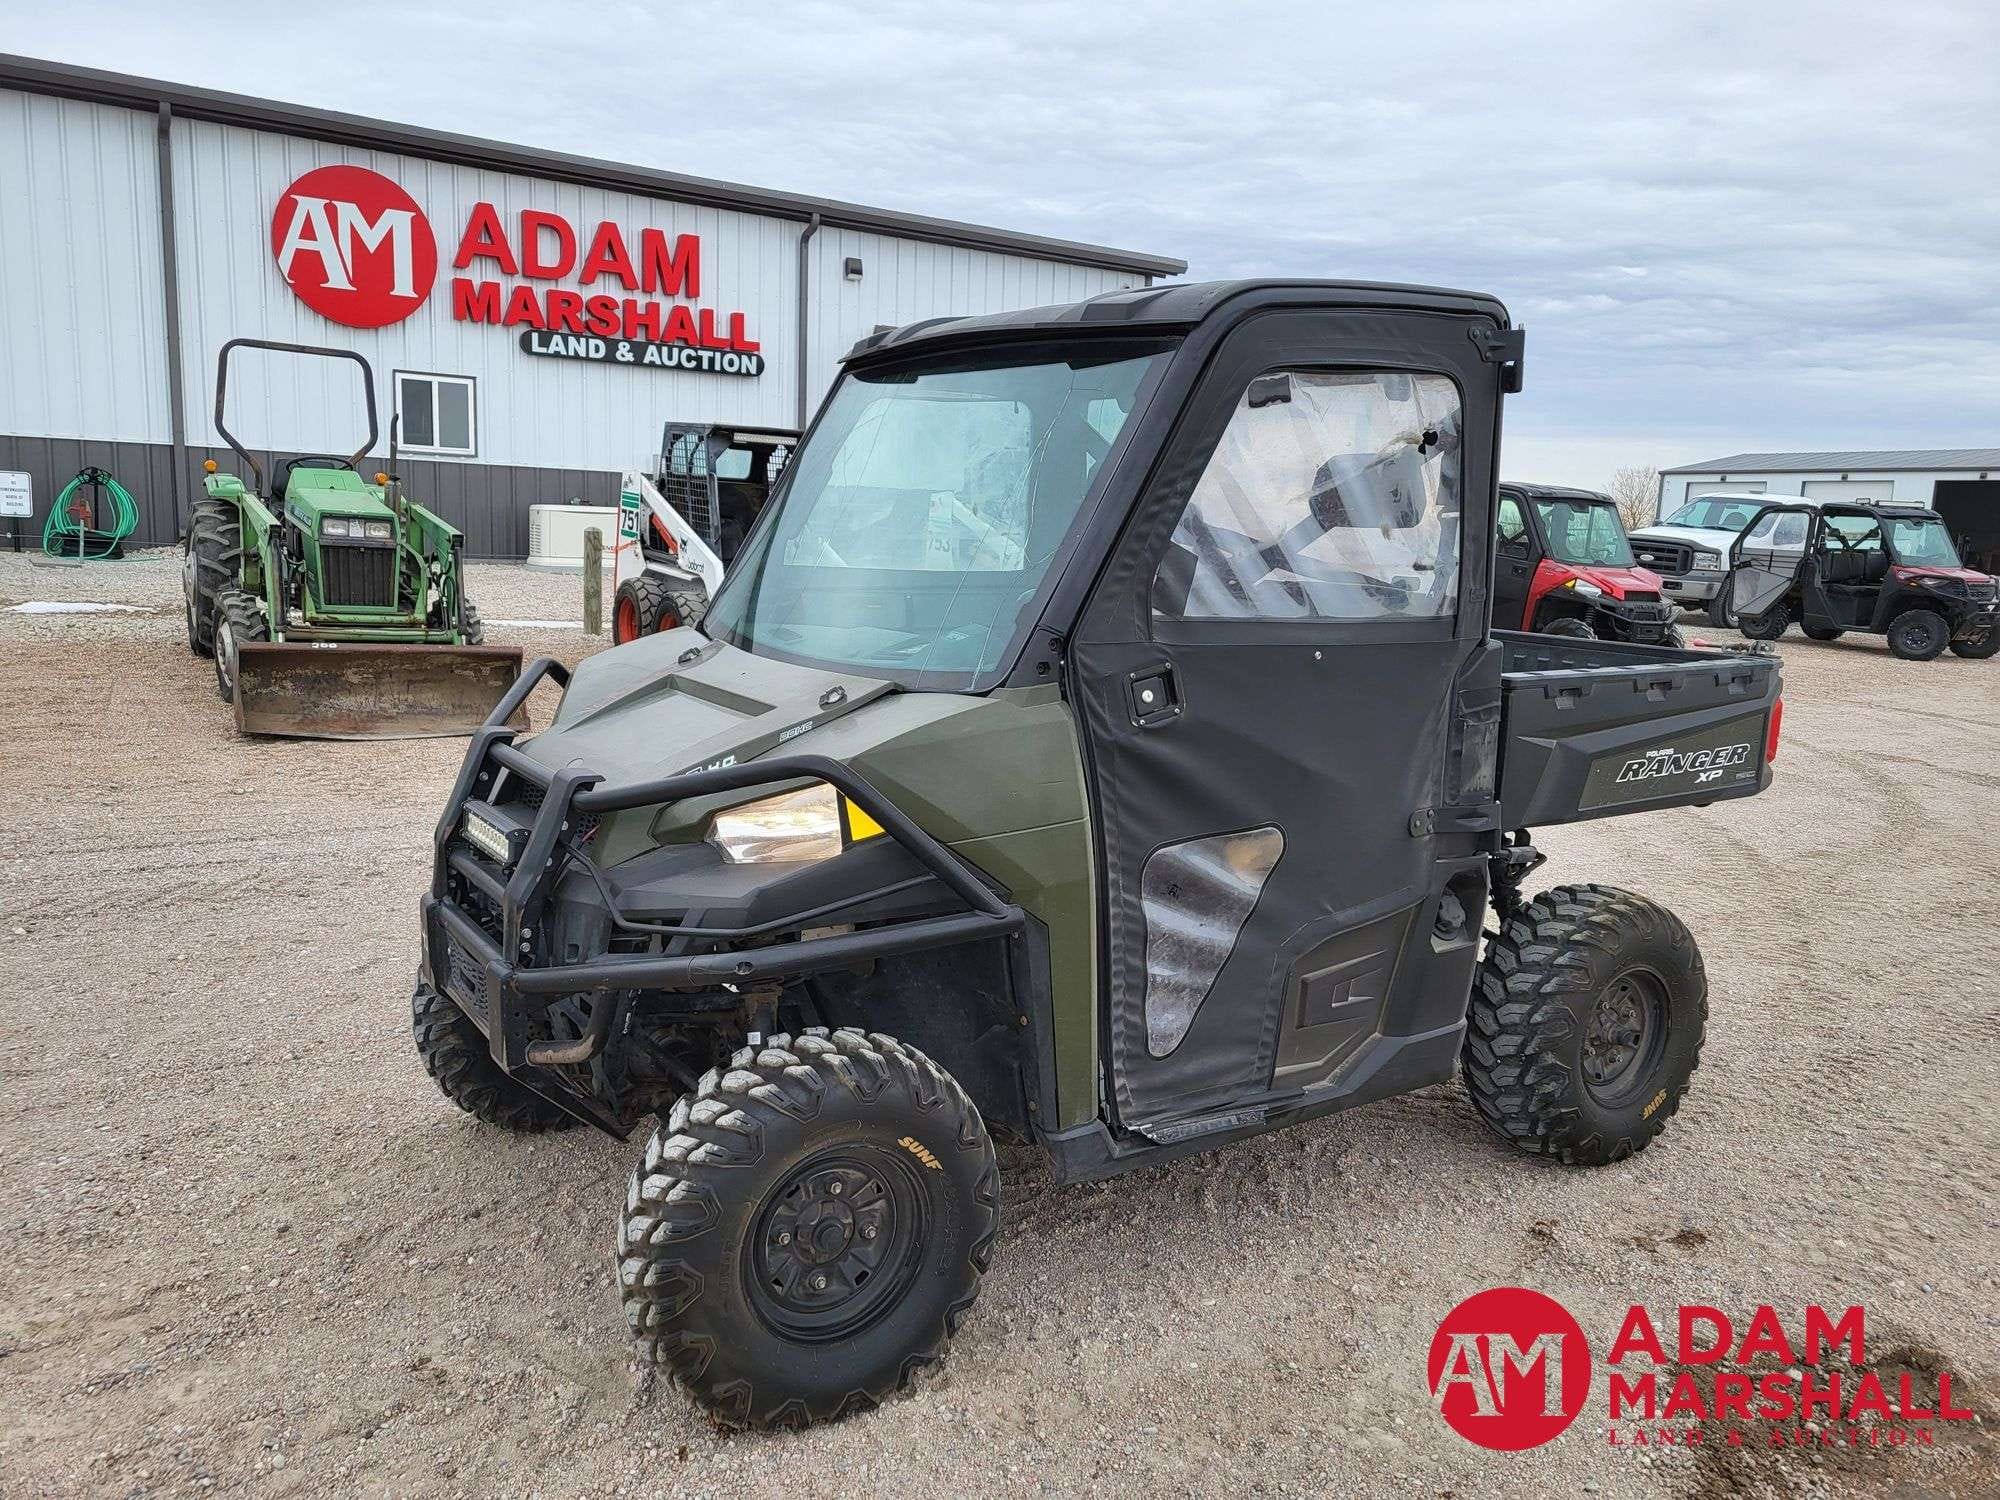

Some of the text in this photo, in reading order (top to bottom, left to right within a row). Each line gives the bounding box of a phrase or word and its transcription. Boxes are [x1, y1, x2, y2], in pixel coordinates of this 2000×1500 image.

[277, 194, 419, 298] AM
[452, 201, 700, 298] ADAM
[452, 277, 760, 352] MARSHALL
[531, 332, 758, 376] LAND & AUCTION
[621, 508, 639, 530] 751
[1615, 743, 1750, 783] RANGER
[1694, 769, 1724, 784] XP
